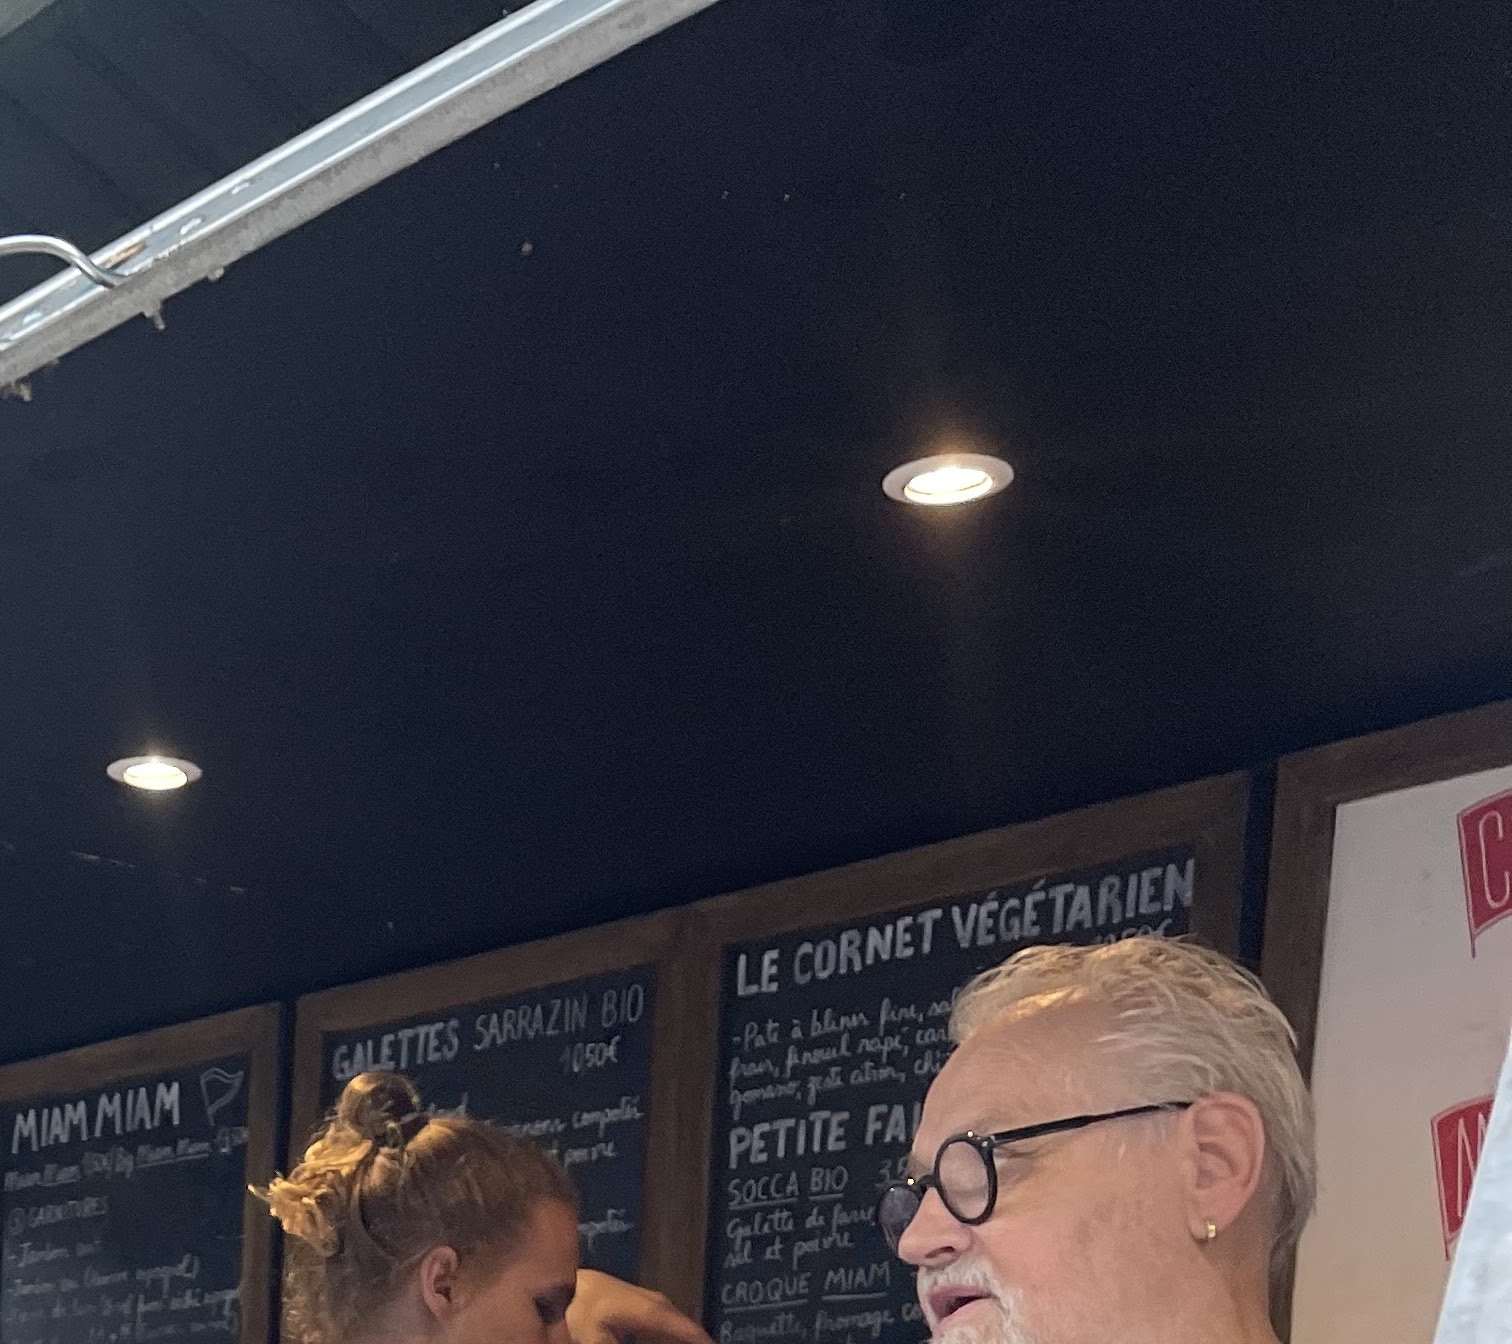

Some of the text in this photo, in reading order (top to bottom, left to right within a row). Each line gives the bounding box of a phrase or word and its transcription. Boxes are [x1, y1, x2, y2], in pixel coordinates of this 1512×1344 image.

[737, 858, 1194, 996] LE CORNET VÉGÉTARIEN
[333, 984, 644, 1081] GALETTES SARRAZIN BIO
[11, 1081, 180, 1155] MIAM MIAM
[728, 1109, 851, 1170] PETITE
[727, 1170, 800, 1208] SOCCA
[809, 1165, 849, 1195] BIO
[721, 1260, 890, 1306] CROQUE MIAM
